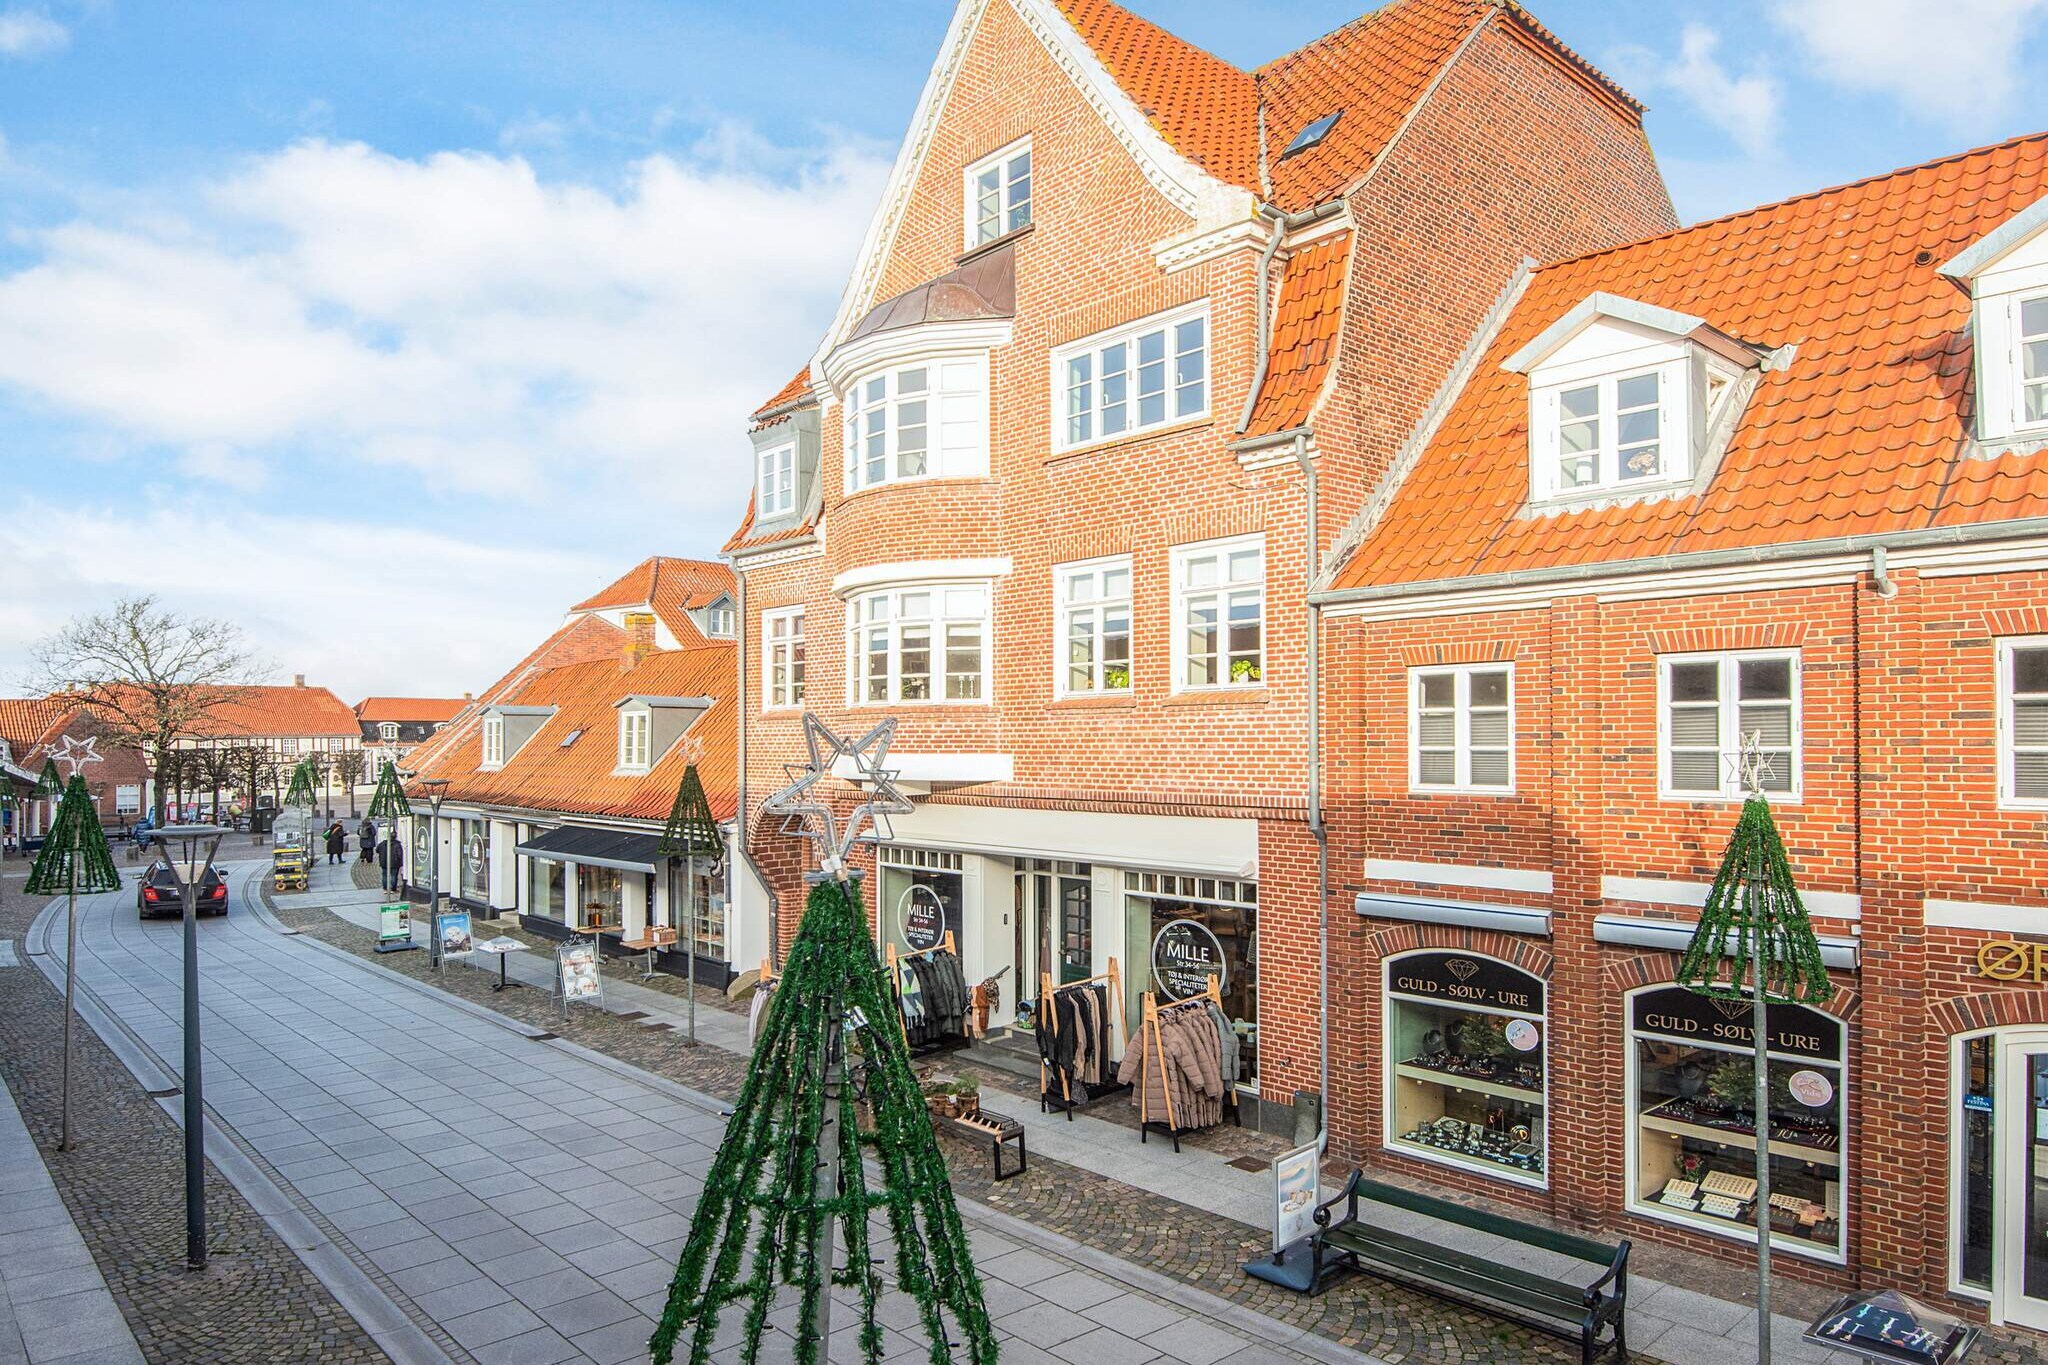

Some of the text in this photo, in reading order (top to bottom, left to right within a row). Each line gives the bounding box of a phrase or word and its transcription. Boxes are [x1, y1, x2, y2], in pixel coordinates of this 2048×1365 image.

[907, 903, 934, 918] MILLE
[1166, 942, 1210, 963] MILLE
[1167, 970, 1177, 978] TØJ
[1182, 988, 1194, 996] VIN
[1398, 977, 1438, 993] GULD
[1448, 983, 1487, 1000] SØLV
[1497, 990, 1529, 1007] URE
[1645, 1013, 1698, 1033] GULD
[1778, 1031, 1821, 1051] URE
